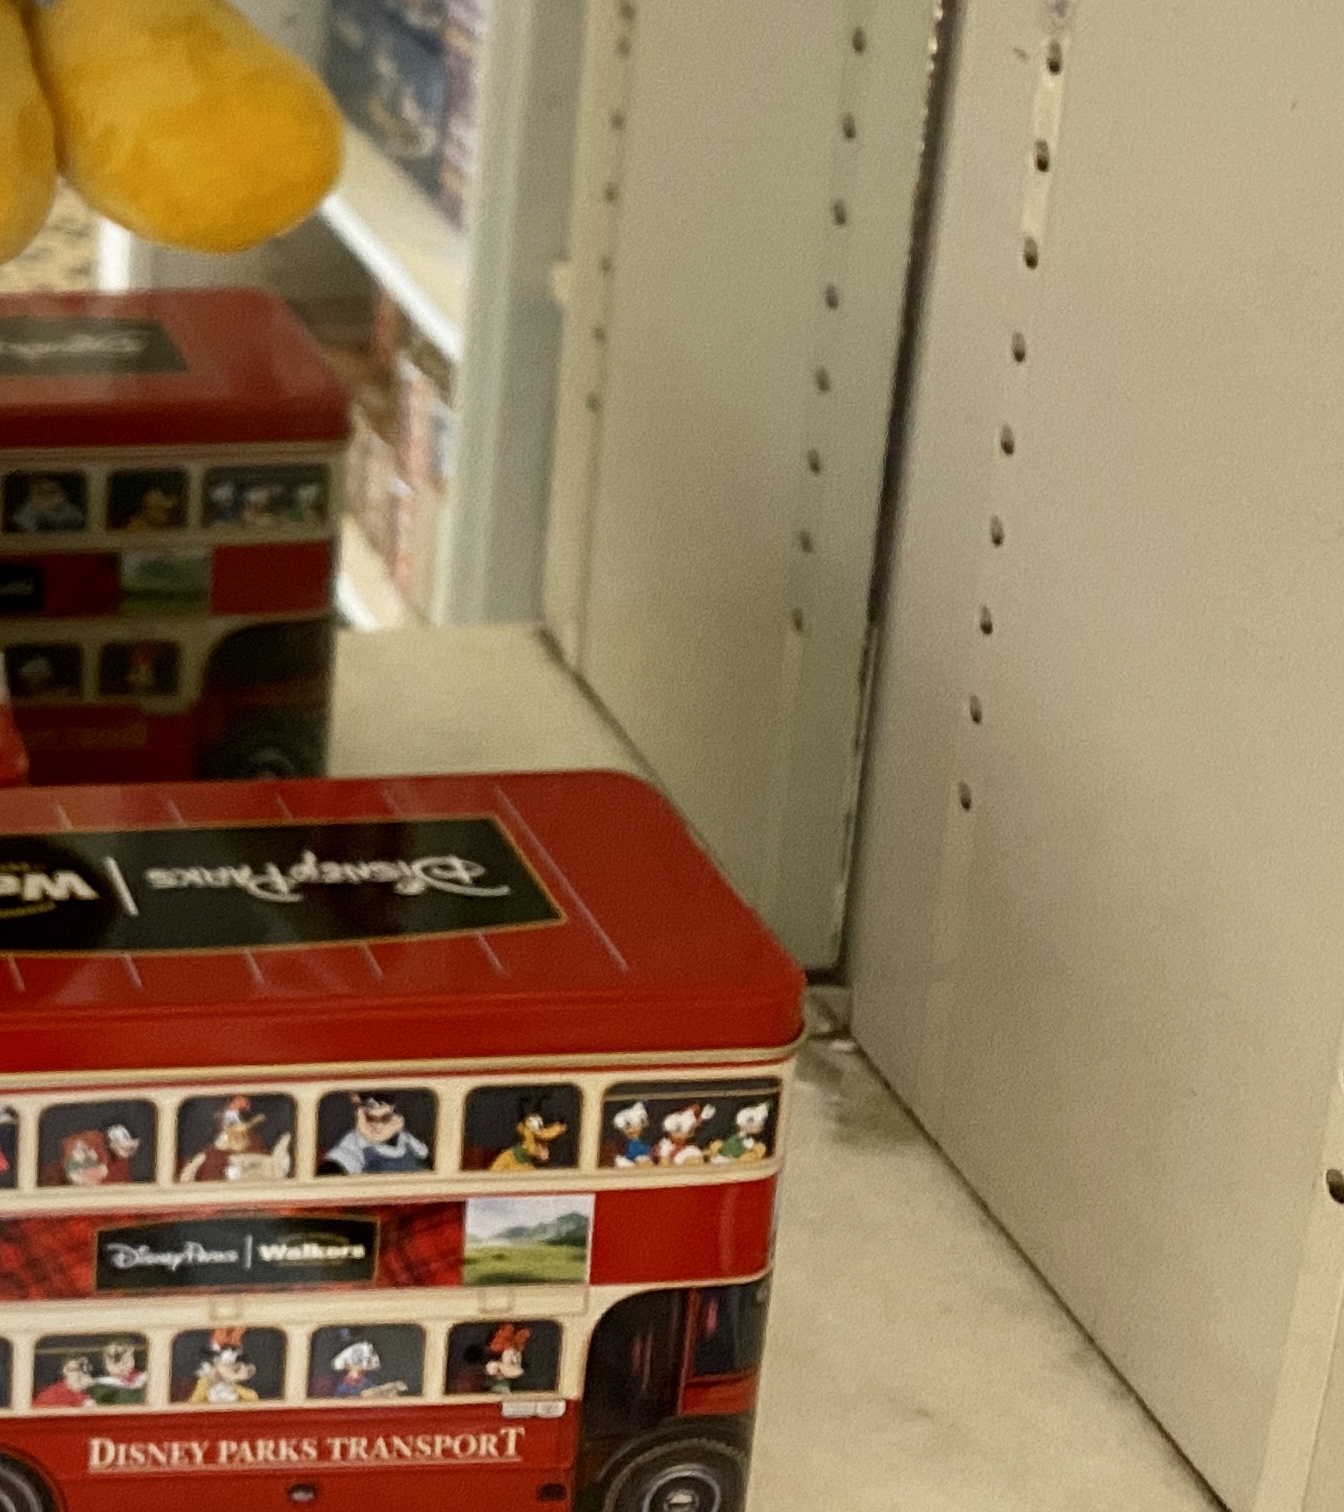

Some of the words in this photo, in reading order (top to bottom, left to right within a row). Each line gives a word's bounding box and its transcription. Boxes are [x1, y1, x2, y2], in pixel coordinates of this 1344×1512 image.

[89, 1437, 210, 1468] DISNEY
[218, 1437, 318, 1464] PARKS
[327, 1426, 526, 1461] TRANSPORT
